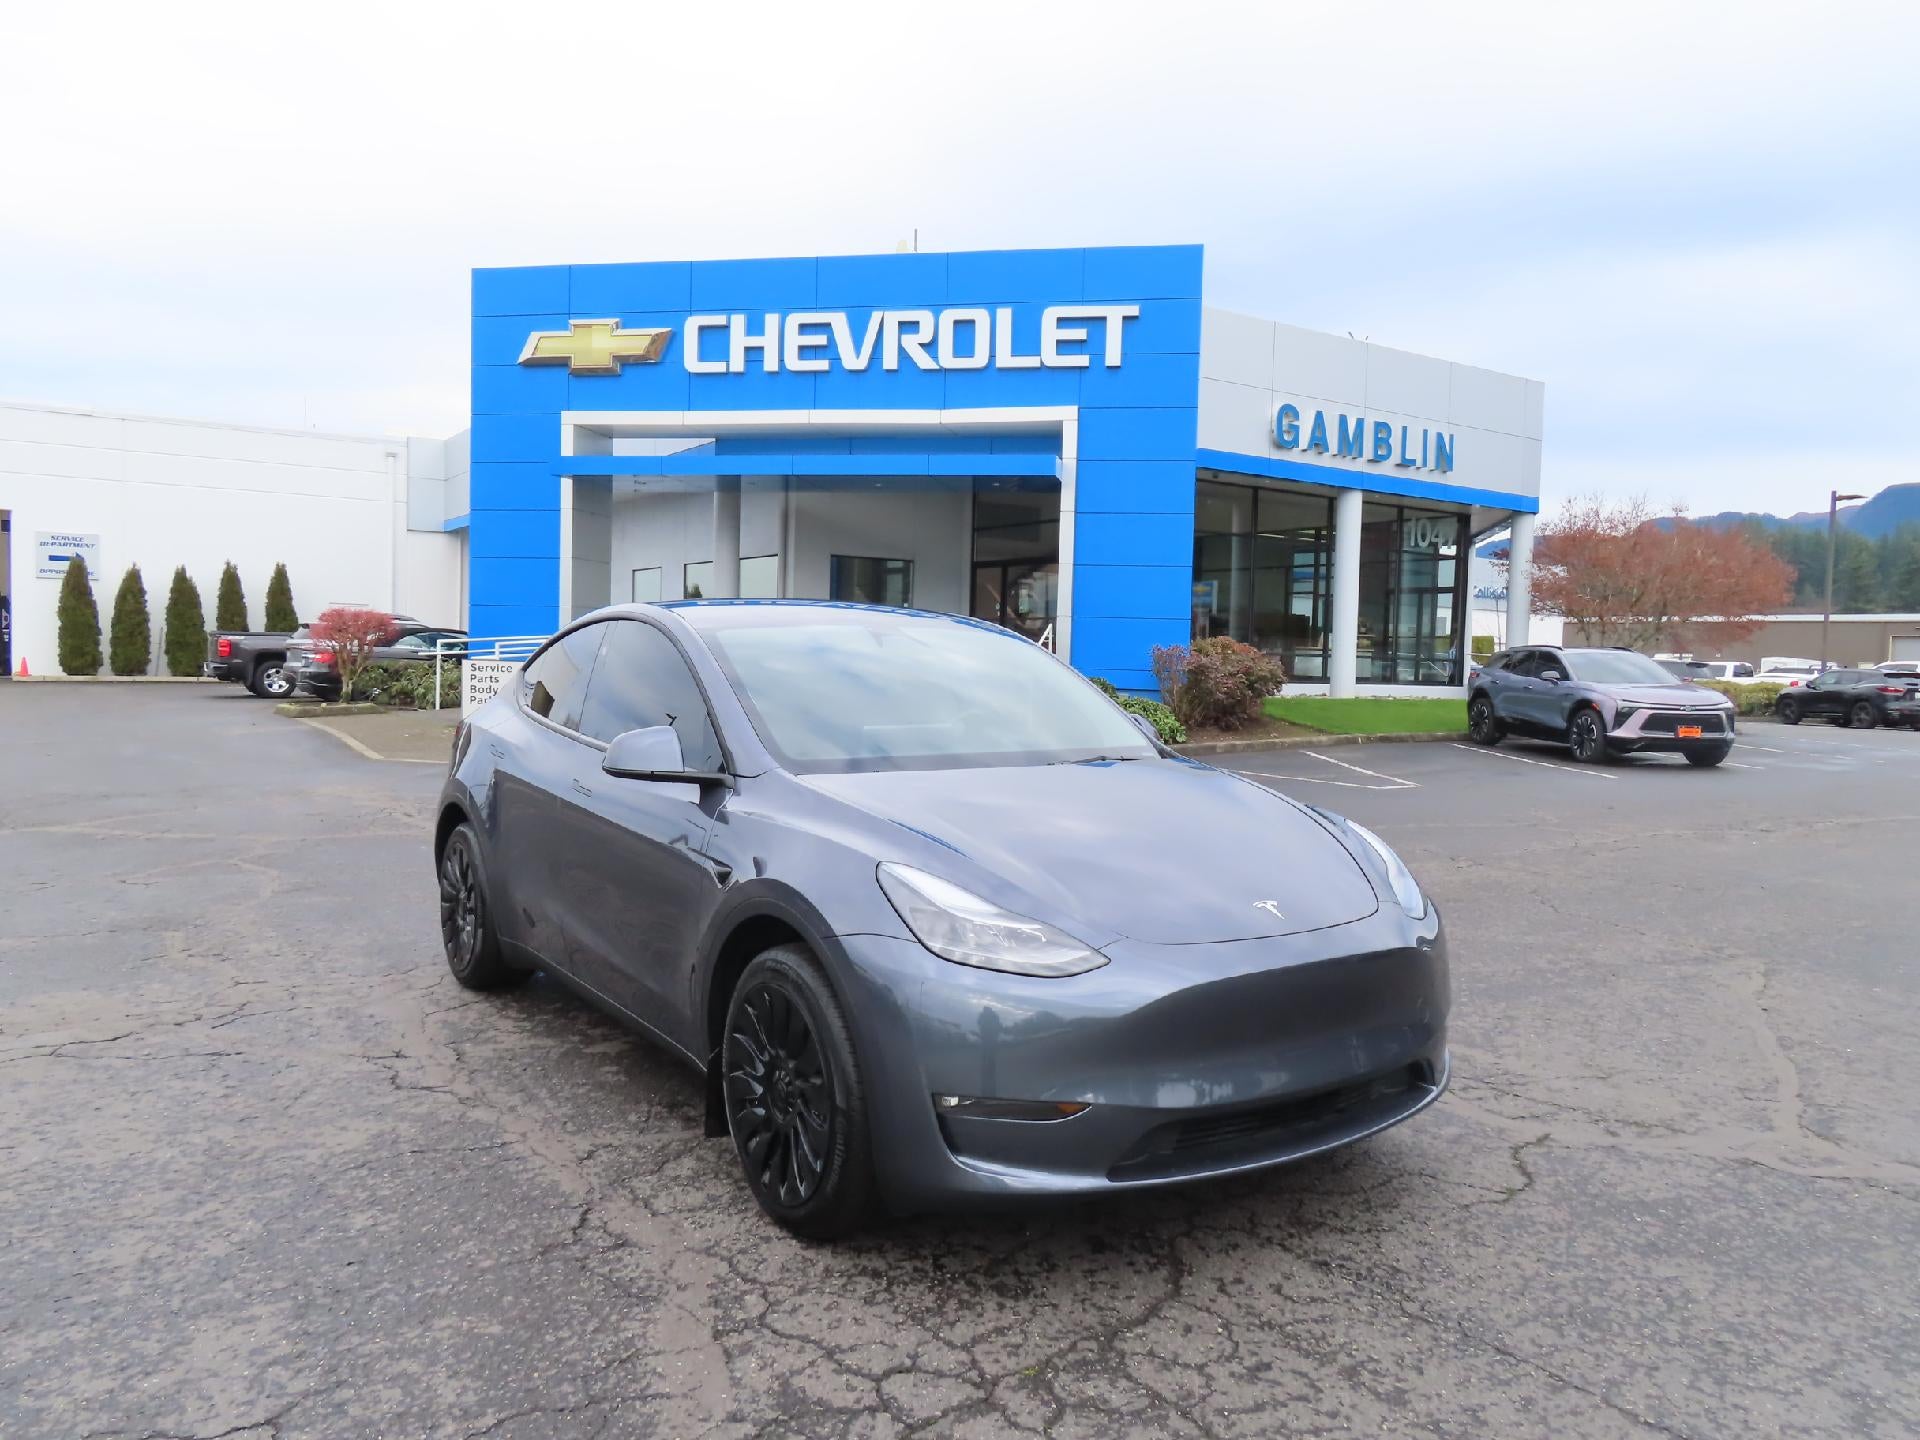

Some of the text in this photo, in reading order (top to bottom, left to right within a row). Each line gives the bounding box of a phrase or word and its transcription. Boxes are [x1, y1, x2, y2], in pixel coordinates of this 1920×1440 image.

[683, 304, 1140, 373] CHEVROLET
[1276, 403, 1455, 472] GAMBLIN
[470, 663, 513, 673] Service
[470, 674, 500, 684] Parts
[470, 685, 499, 696] Body
[469, 696, 492, 705] Par
